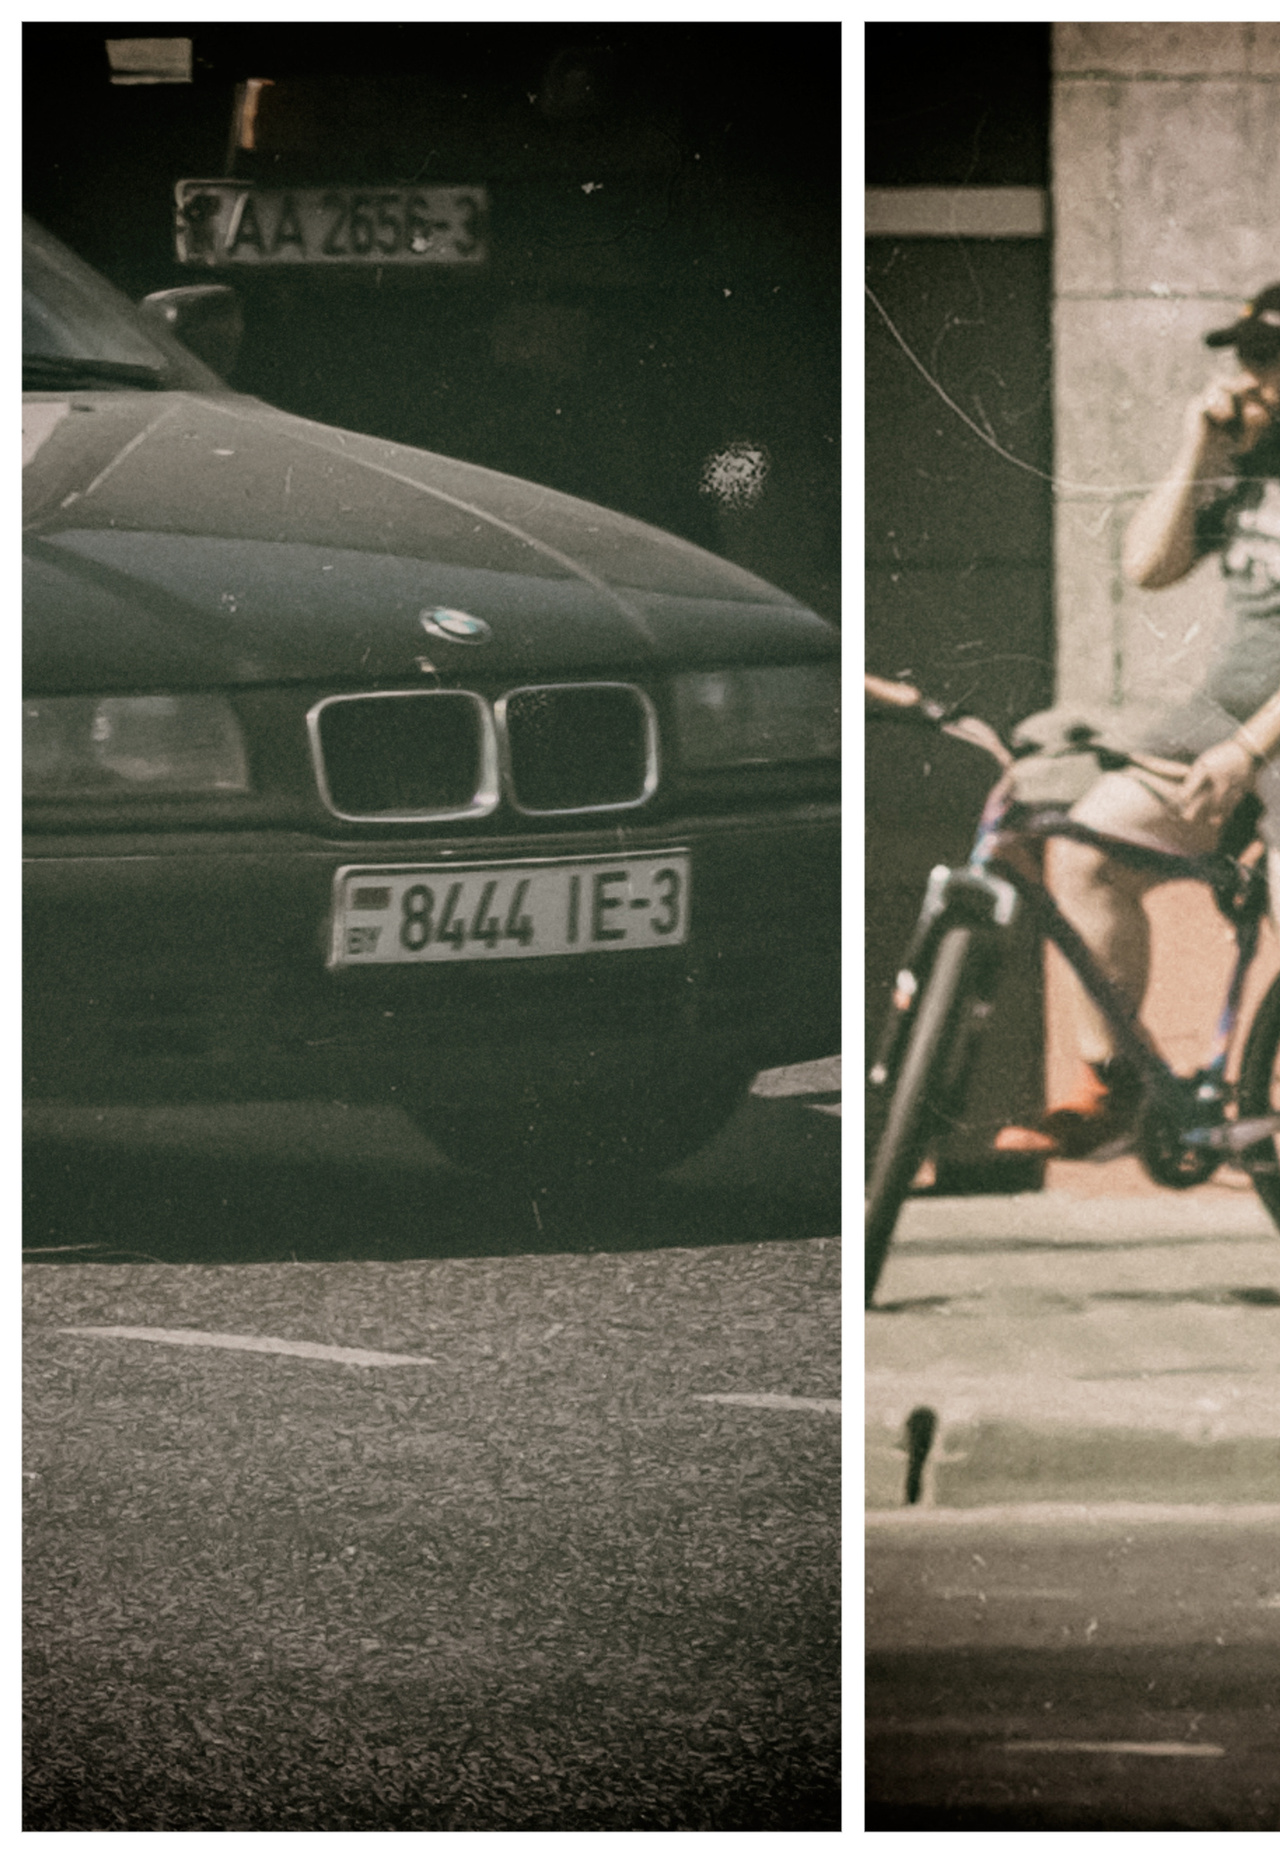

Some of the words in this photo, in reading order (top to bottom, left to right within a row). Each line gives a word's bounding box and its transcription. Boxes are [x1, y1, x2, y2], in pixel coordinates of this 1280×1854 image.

[230, 193, 307, 256] AA
[348, 926, 380, 954] BY
[402, 878, 535, 952] 8444
[566, 867, 682, 943] IE-3
